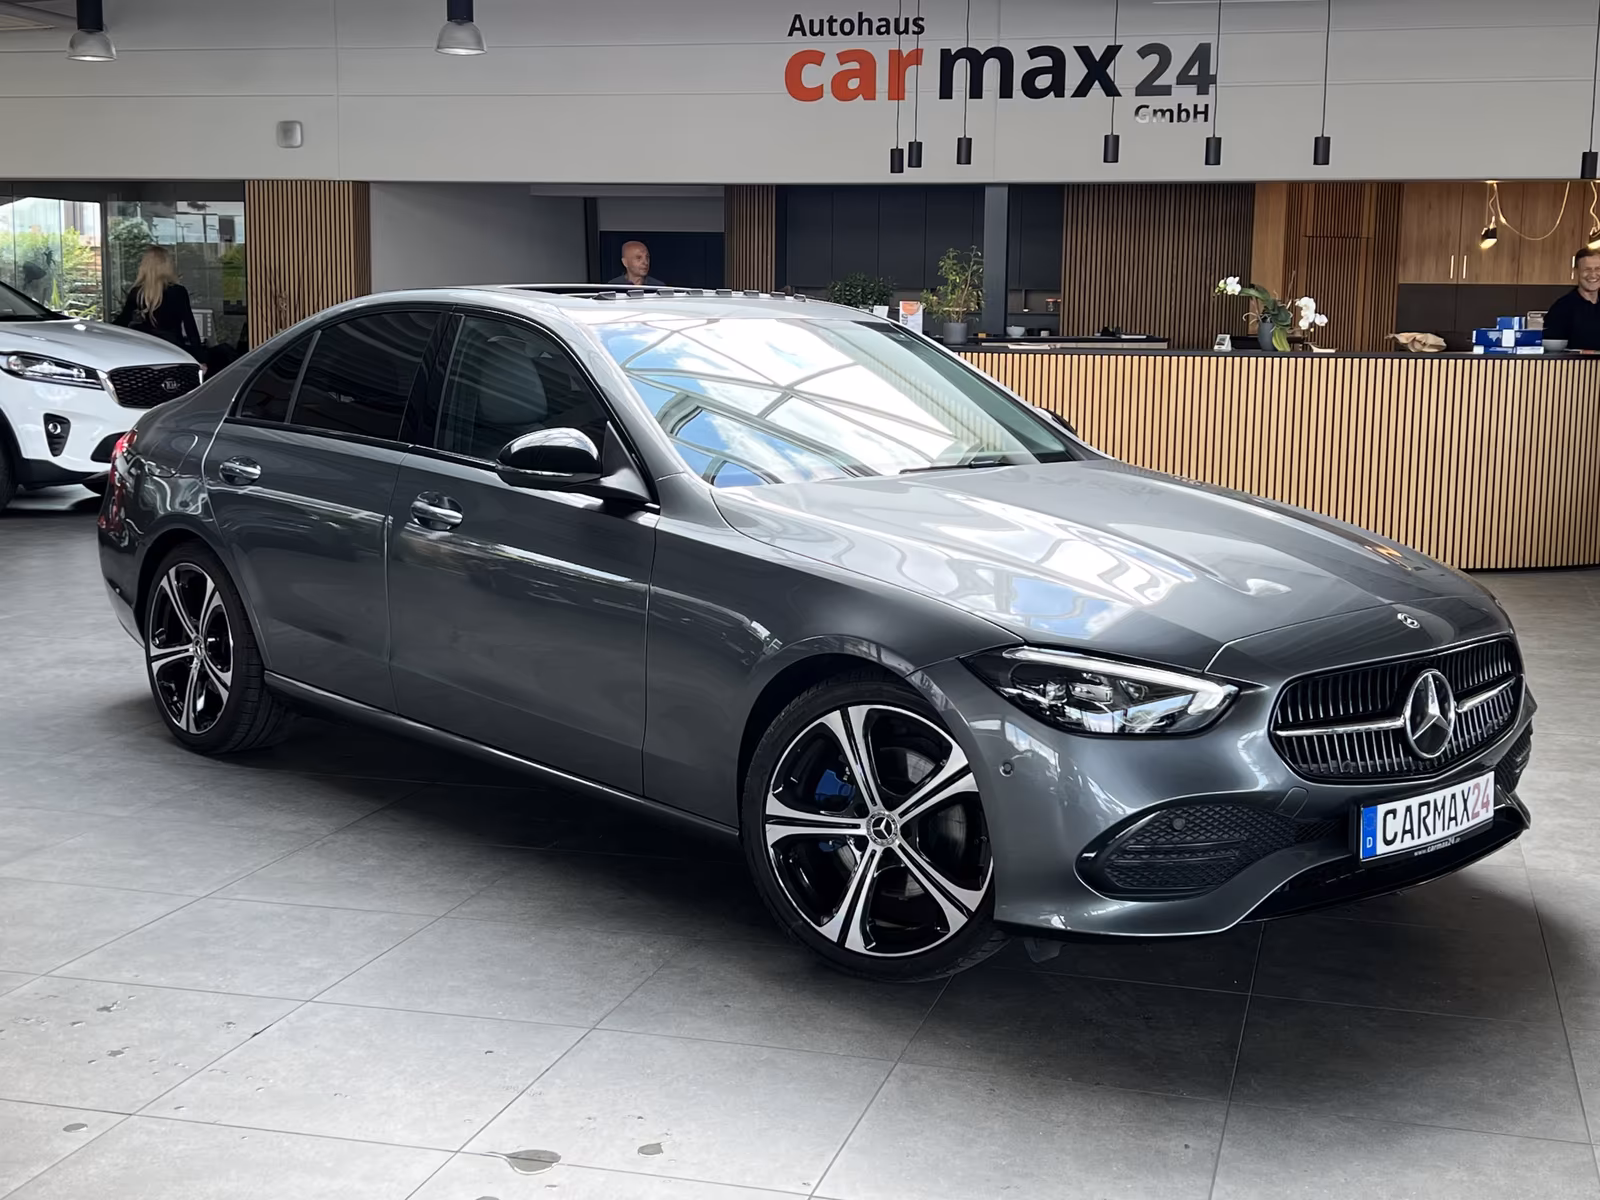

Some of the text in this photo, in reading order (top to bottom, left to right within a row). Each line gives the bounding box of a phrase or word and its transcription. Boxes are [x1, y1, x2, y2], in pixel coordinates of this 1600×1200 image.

[787, 12, 925, 37] Autohaus
[1134, 103, 1209, 123] GmbH
[1366, 836, 1373, 848] D
